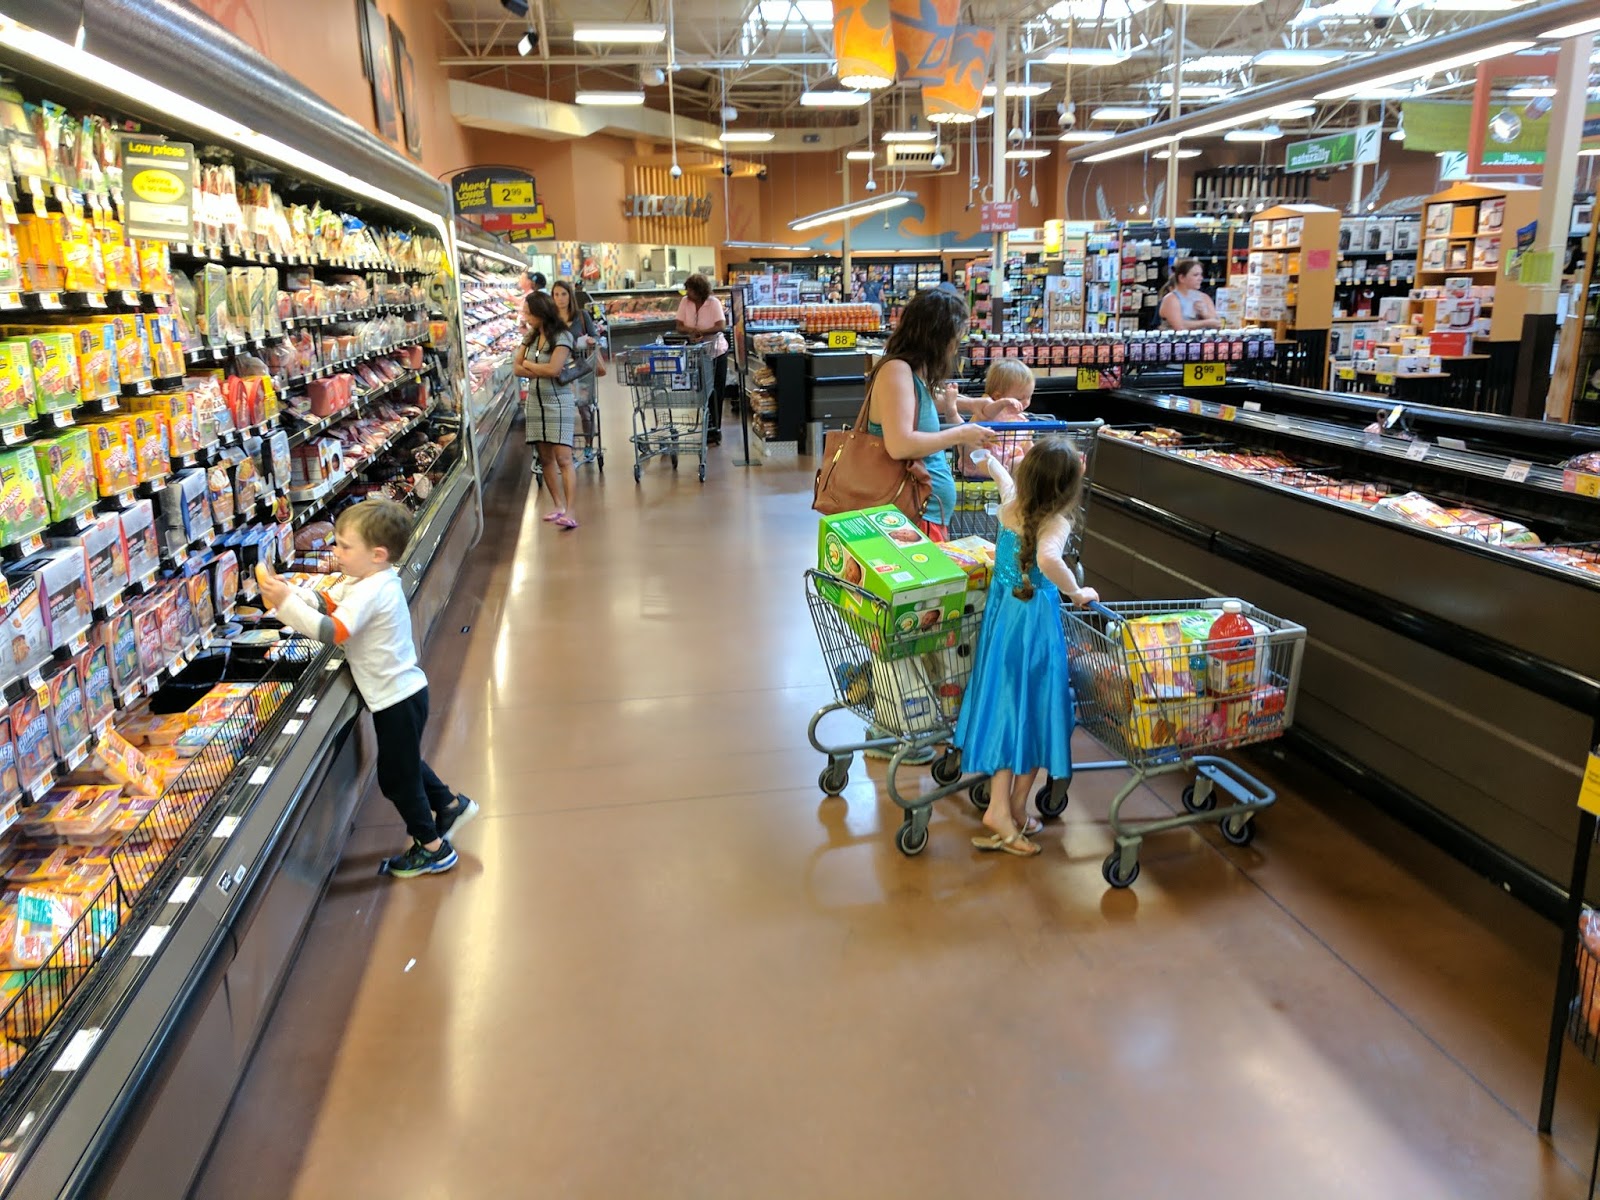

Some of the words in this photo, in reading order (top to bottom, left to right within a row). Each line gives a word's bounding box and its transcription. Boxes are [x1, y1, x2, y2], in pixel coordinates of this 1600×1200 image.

[129, 142, 151, 153] Low
[153, 145, 185, 157] prices
[1291, 148, 1330, 165] naturally
[459, 178, 490, 192] More!
[456, 189, 485, 201] Lower
[460, 197, 487, 209] prices
[5, 580, 36, 615] UPLOADED
[18, 715, 48, 754] CRACKER
